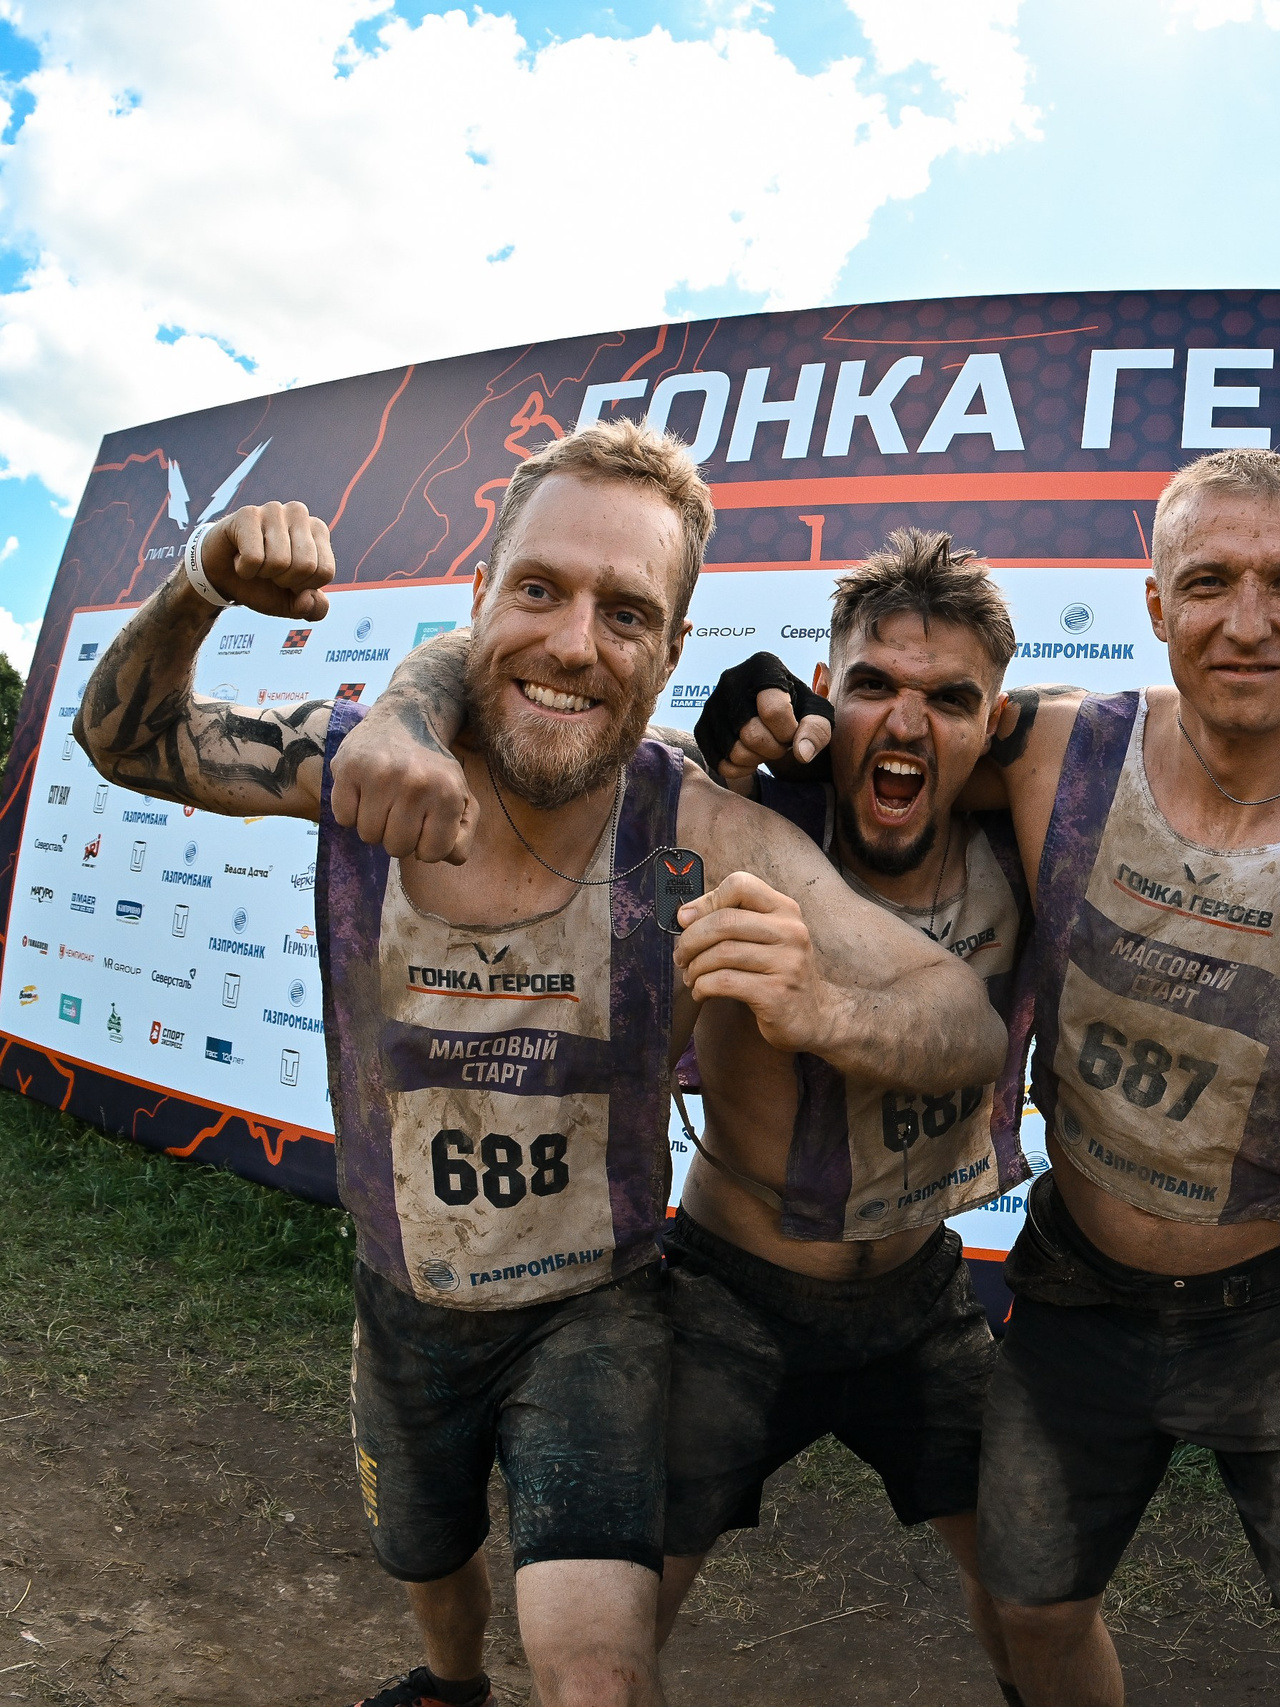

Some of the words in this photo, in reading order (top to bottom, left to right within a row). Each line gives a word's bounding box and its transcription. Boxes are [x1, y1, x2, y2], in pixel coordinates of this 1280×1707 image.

[575, 353, 1024, 463] ГОНКА
[144, 546, 175, 561] ЛИГА
[190, 545, 199, 572] ГОНКА
[220, 634, 255, 650] CITYZEN
[696, 627, 756, 637] GROUP
[325, 648, 391, 663] ГАЗПРОМБАНК
[1014, 642, 1134, 660] ГАЗПРОМБАНК
[267, 692, 309, 701] ЧЕМПИОНАТ
[122, 810, 168, 826] ГАЗПРОМБАНК
[34, 838, 63, 853] Северсталь
[162, 870, 213, 889] ГАЗПРОМБАНК
[224, 864, 246, 876] Белая
[248, 866, 269, 878] Дача
[30, 886, 54, 900] МАГУРО
[77, 894, 96, 906] MAER
[1117, 863, 1182, 908] ГОНКА
[1189, 894, 1274, 929] ГЕРОЕВ
[208, 937, 266, 959] ГАЗПРОМБАНК
[950, 928, 996, 958] ЕРОЕВ
[114, 962, 142, 976] GROUP
[1110, 937, 1239, 992] МАССОВЫЙ
[152, 970, 192, 990] Северсталь
[408, 966, 482, 992] ГОНКА
[489, 973, 575, 993] ГЕРОЕВ
[1130, 974, 1200, 1009] СТАРТ
[262, 1009, 324, 1034] ГАЗПРОМБАНК
[162, 1028, 185, 1042] СПОРТ
[429, 1032, 559, 1061] МАССОВЫЙ
[461, 1062, 528, 1087] СТАРТ
[1079, 1021, 1219, 1122] 687
[431, 1129, 570, 1209] 688
[1088, 1138, 1219, 1203] ГАЗПРОМБАНК
[897, 1155, 991, 1209] ГАЗПРОМБАНК
[470, 1249, 604, 1287] ГАЗПРОМБАНК
